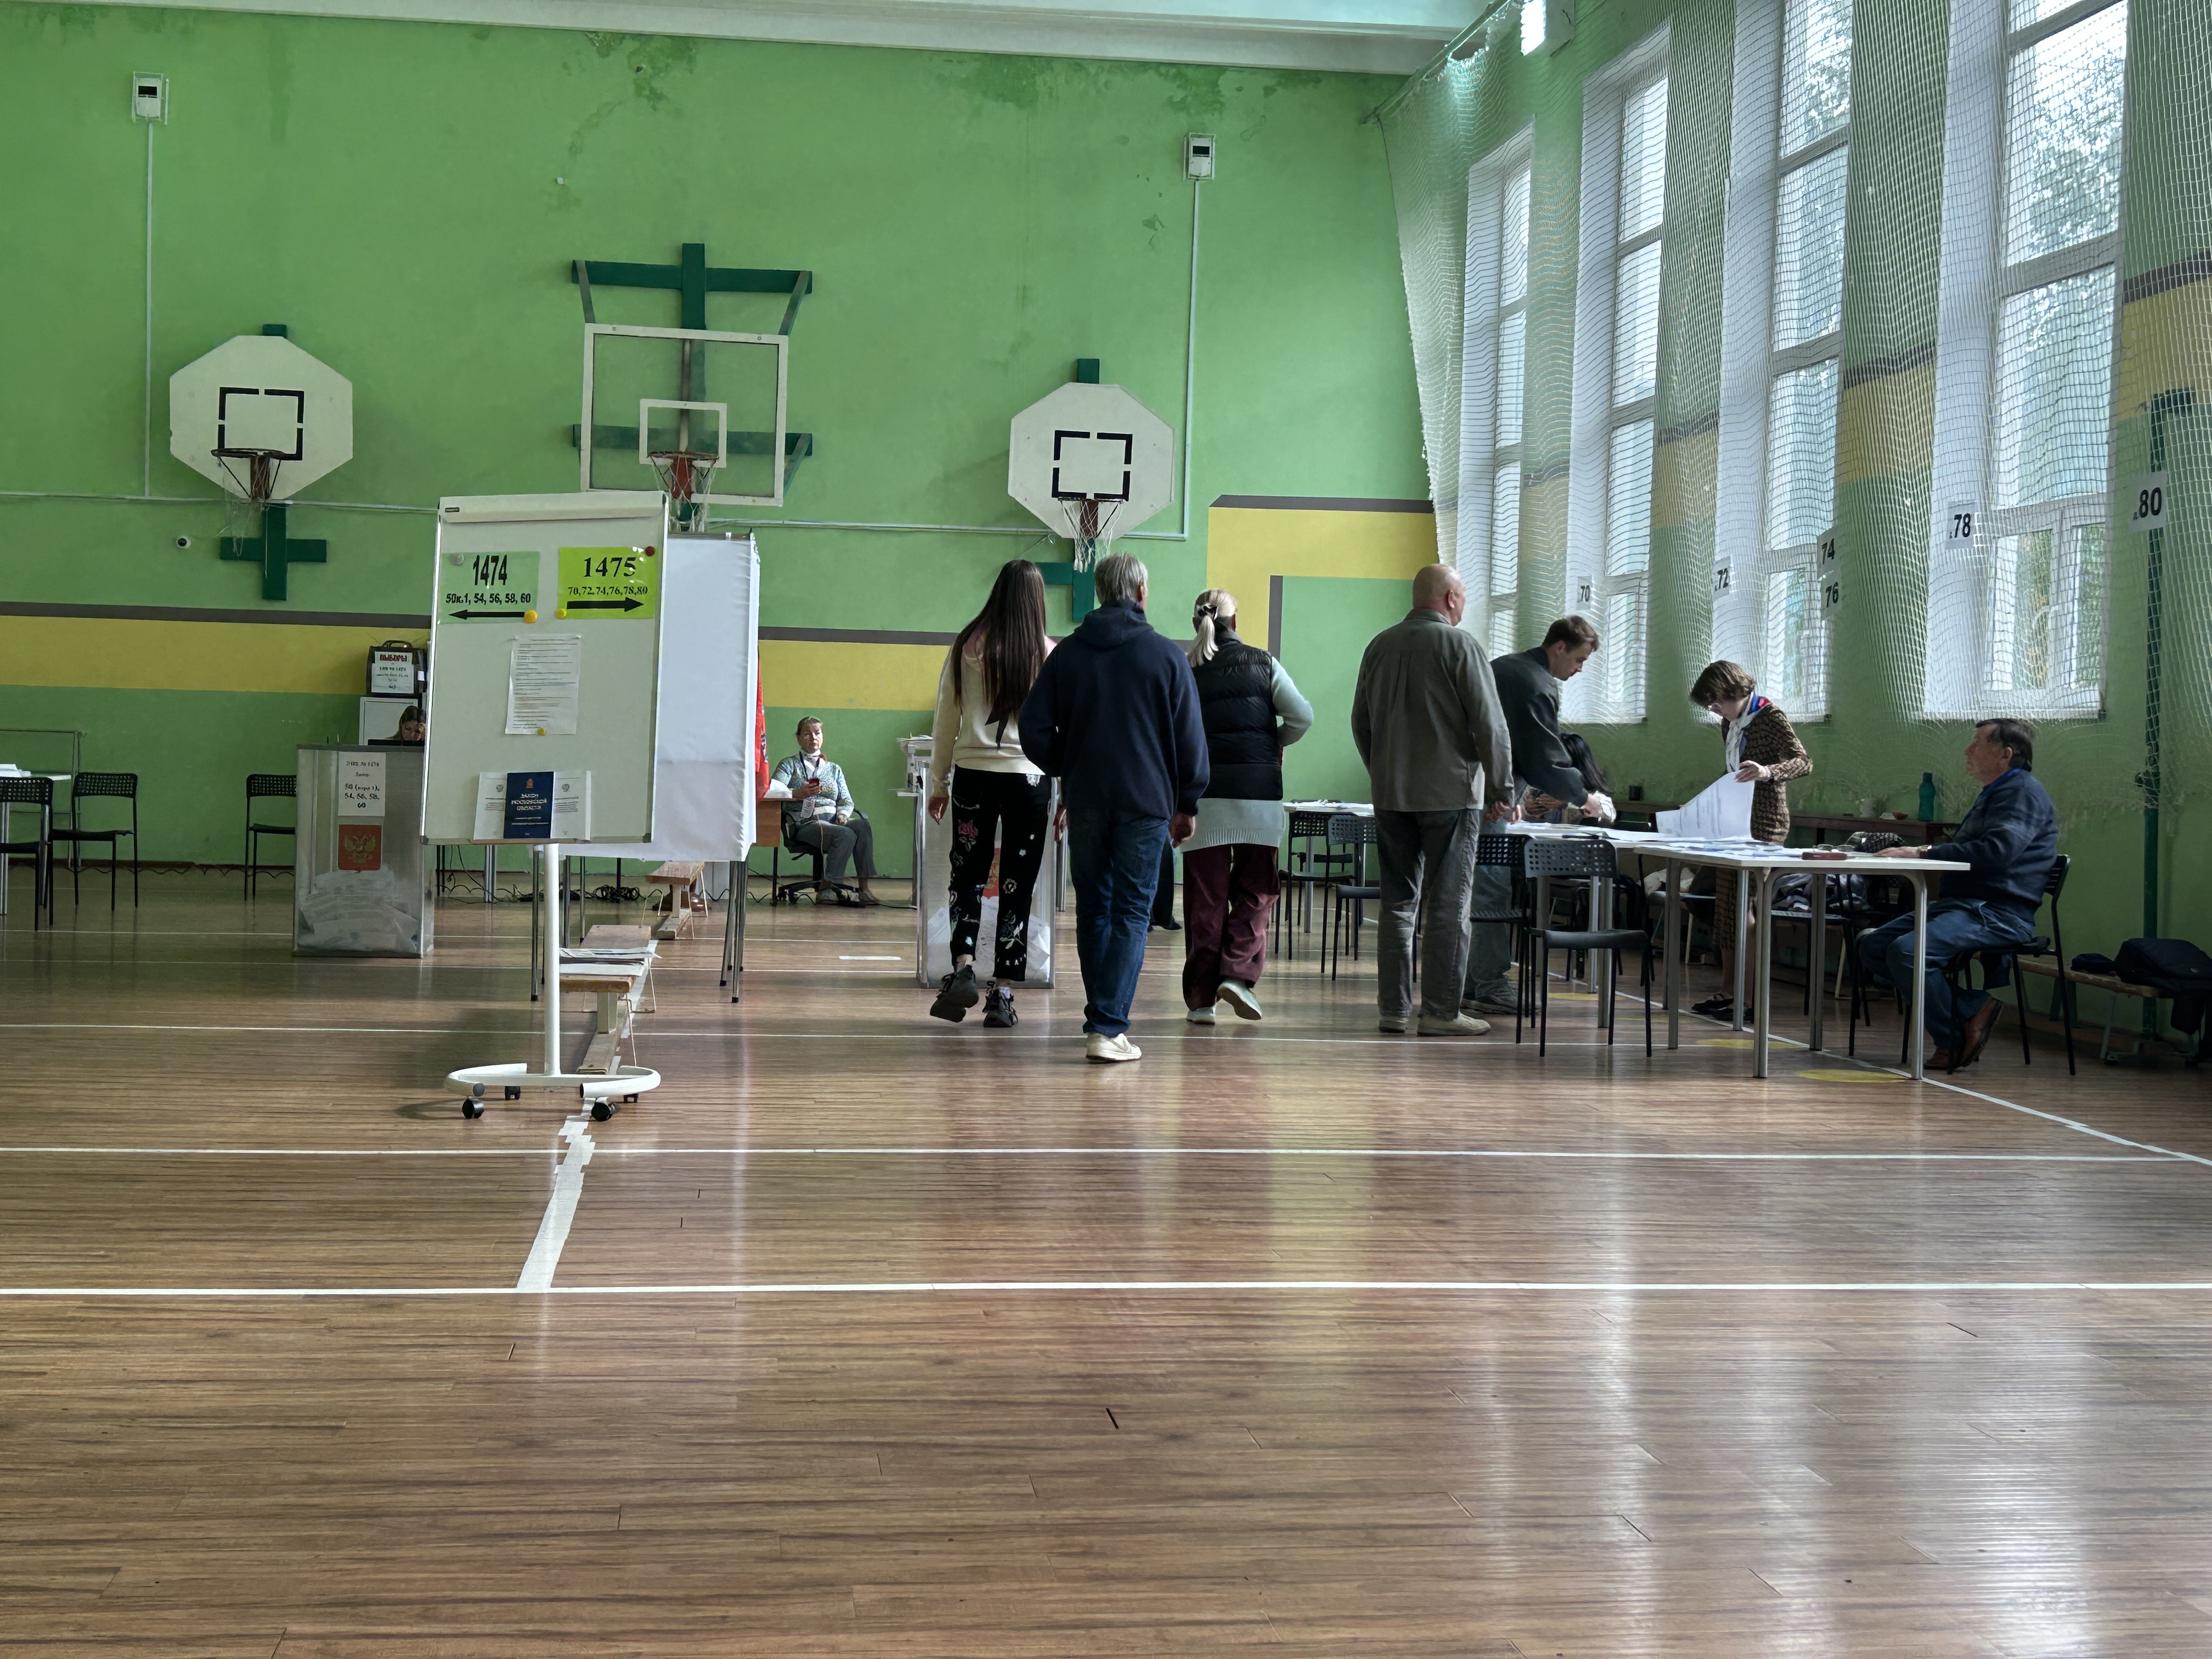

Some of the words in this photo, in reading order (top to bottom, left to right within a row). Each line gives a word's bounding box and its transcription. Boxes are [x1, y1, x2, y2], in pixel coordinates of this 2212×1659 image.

[473, 555, 507, 585] 1474
[583, 557, 636, 577] 1475
[473, 593, 487, 605] 54,
[489, 593, 502, 605] 56,
[505, 593, 518, 605] 58,
[521, 593, 531, 603] 60
